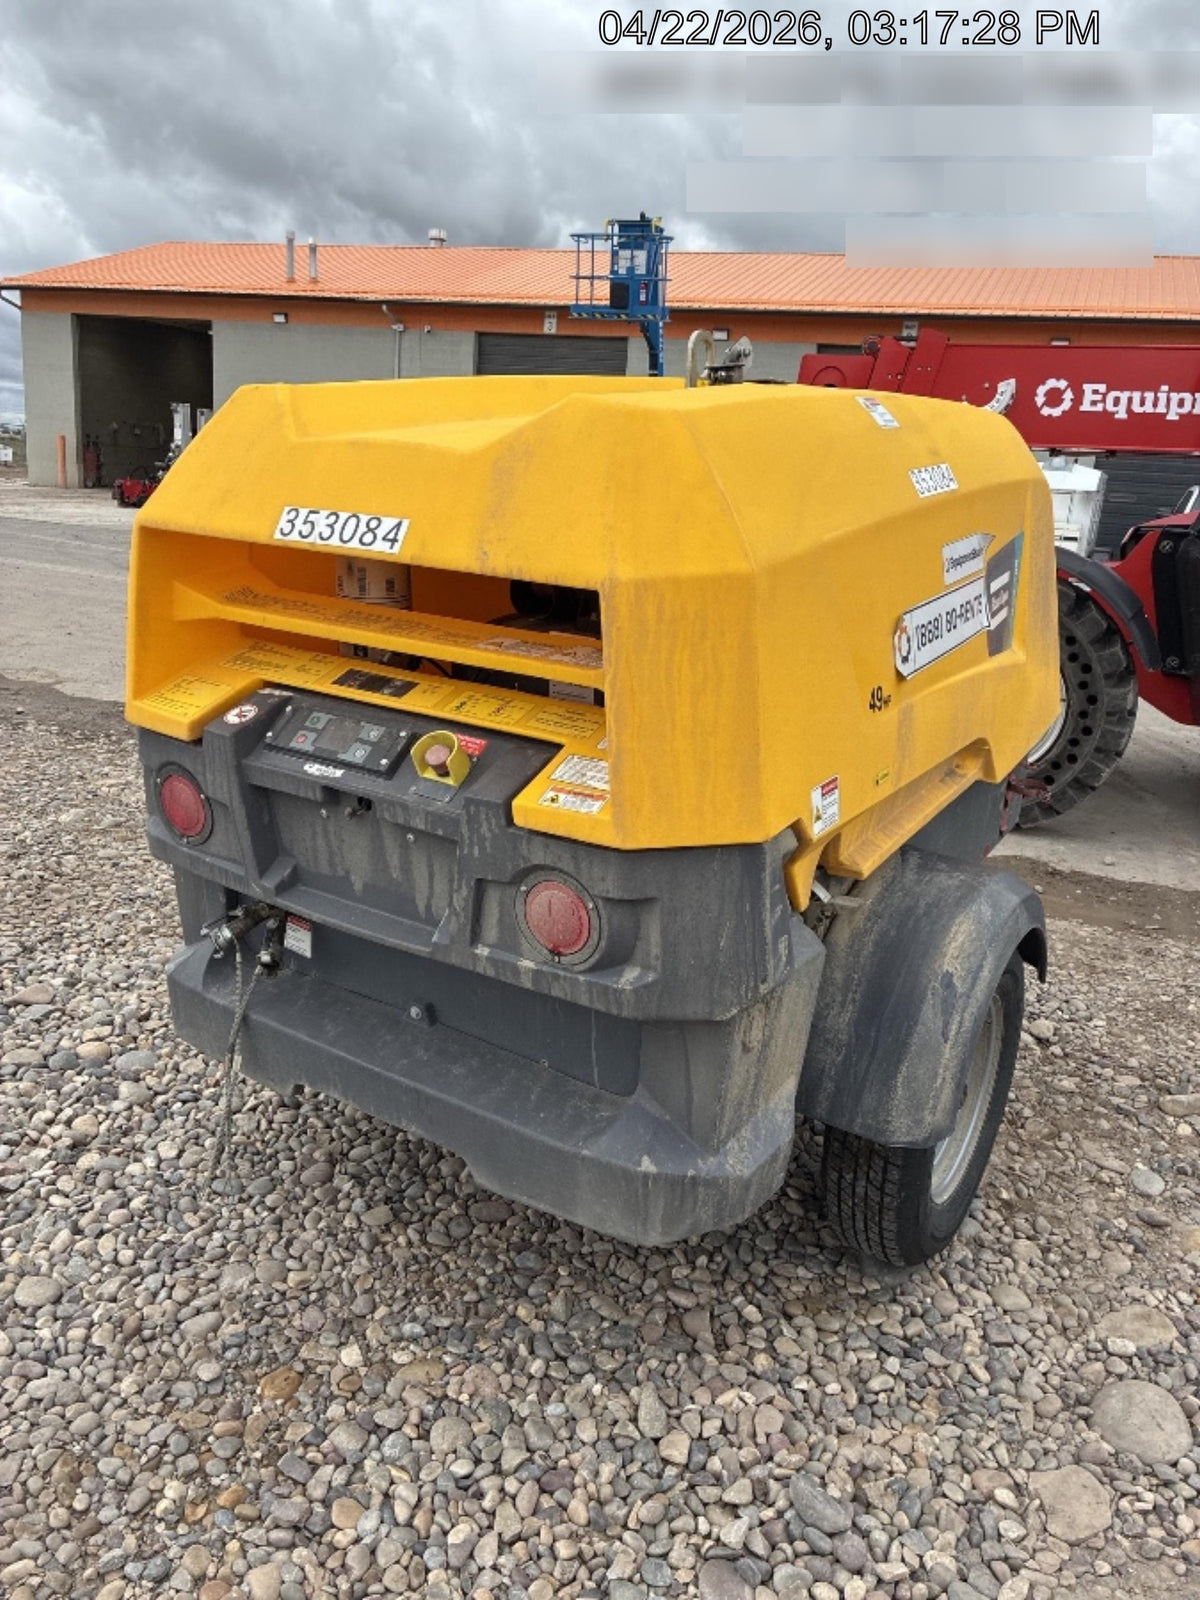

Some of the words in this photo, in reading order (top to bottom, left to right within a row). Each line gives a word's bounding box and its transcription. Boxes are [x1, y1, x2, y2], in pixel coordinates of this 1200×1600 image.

[1079, 383, 1200, 420] Equip
[279, 507, 404, 550] 353084
[868, 685, 882, 714] 49
